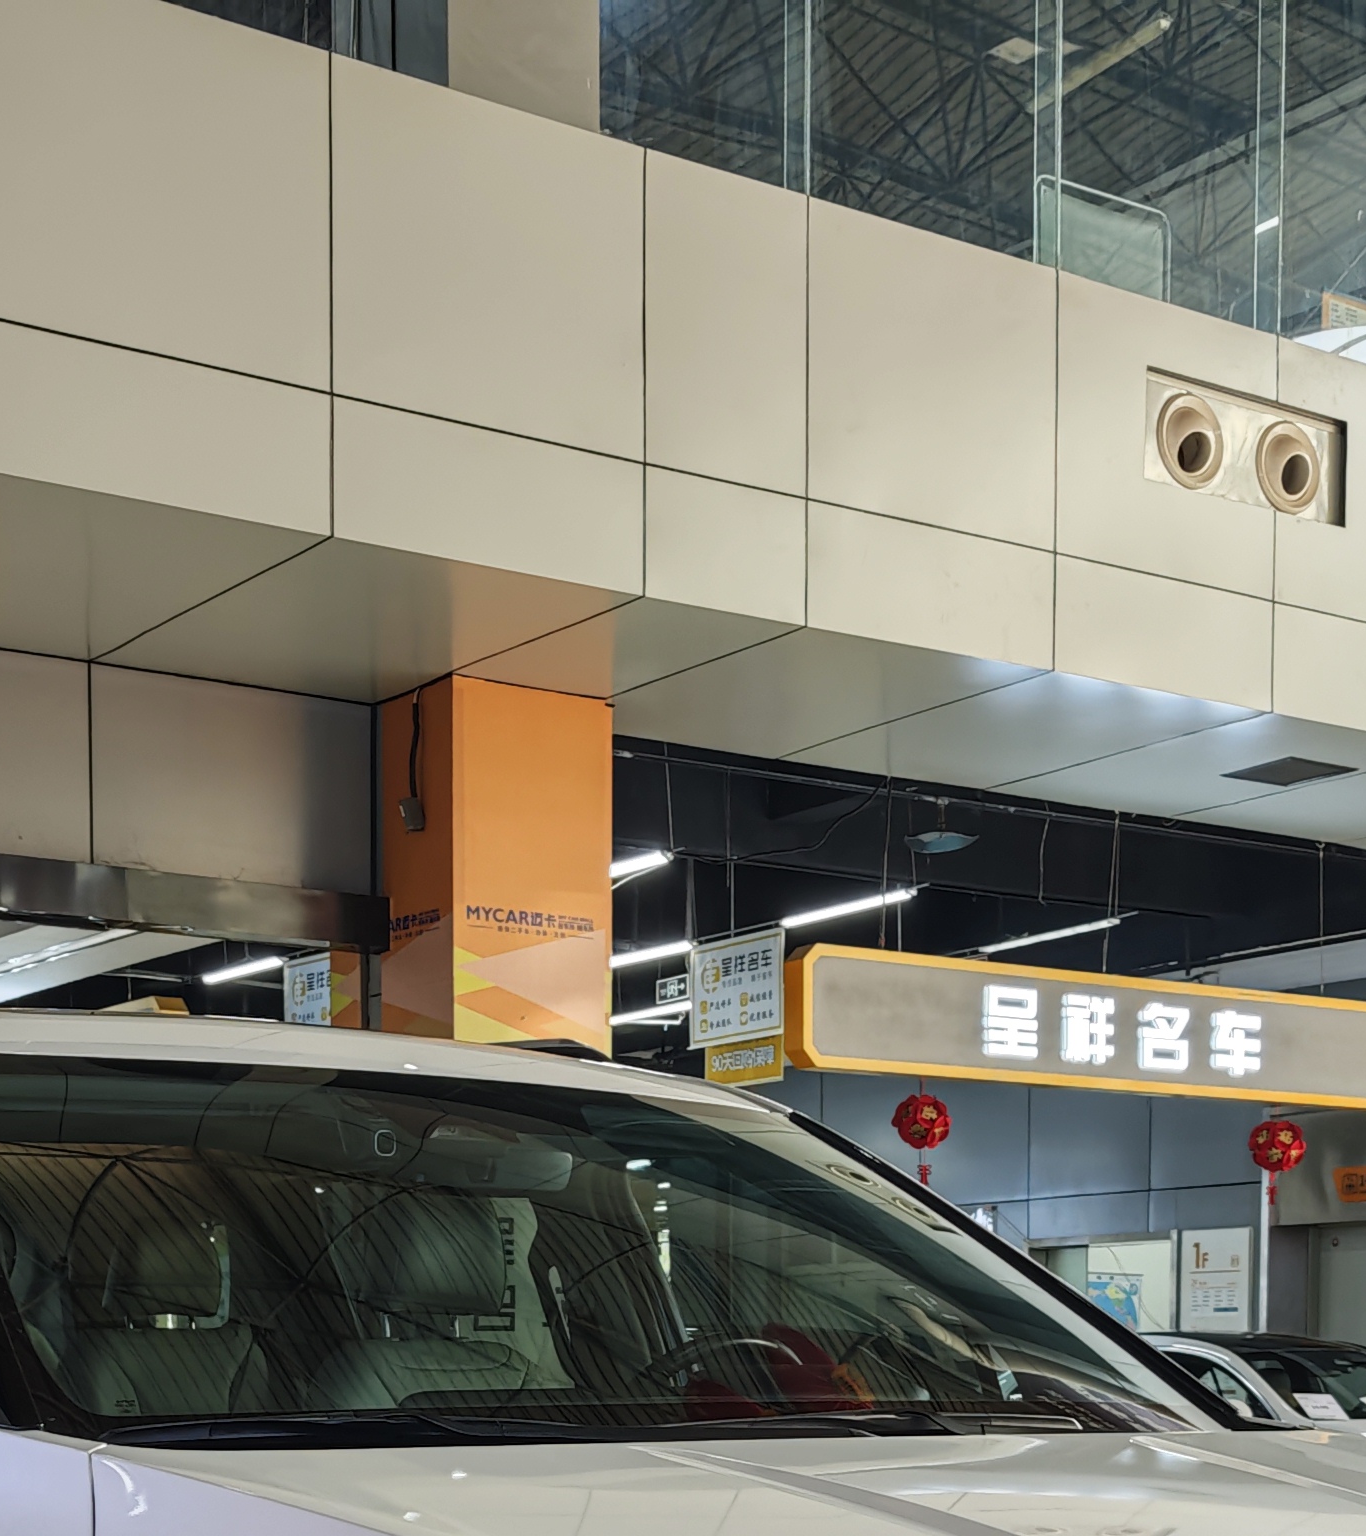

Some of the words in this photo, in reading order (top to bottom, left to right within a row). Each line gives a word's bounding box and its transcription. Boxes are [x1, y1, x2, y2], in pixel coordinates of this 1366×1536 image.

[721, 949, 773, 978] 呈祥名车
[981, 983, 1263, 1077] 呈祥名车
